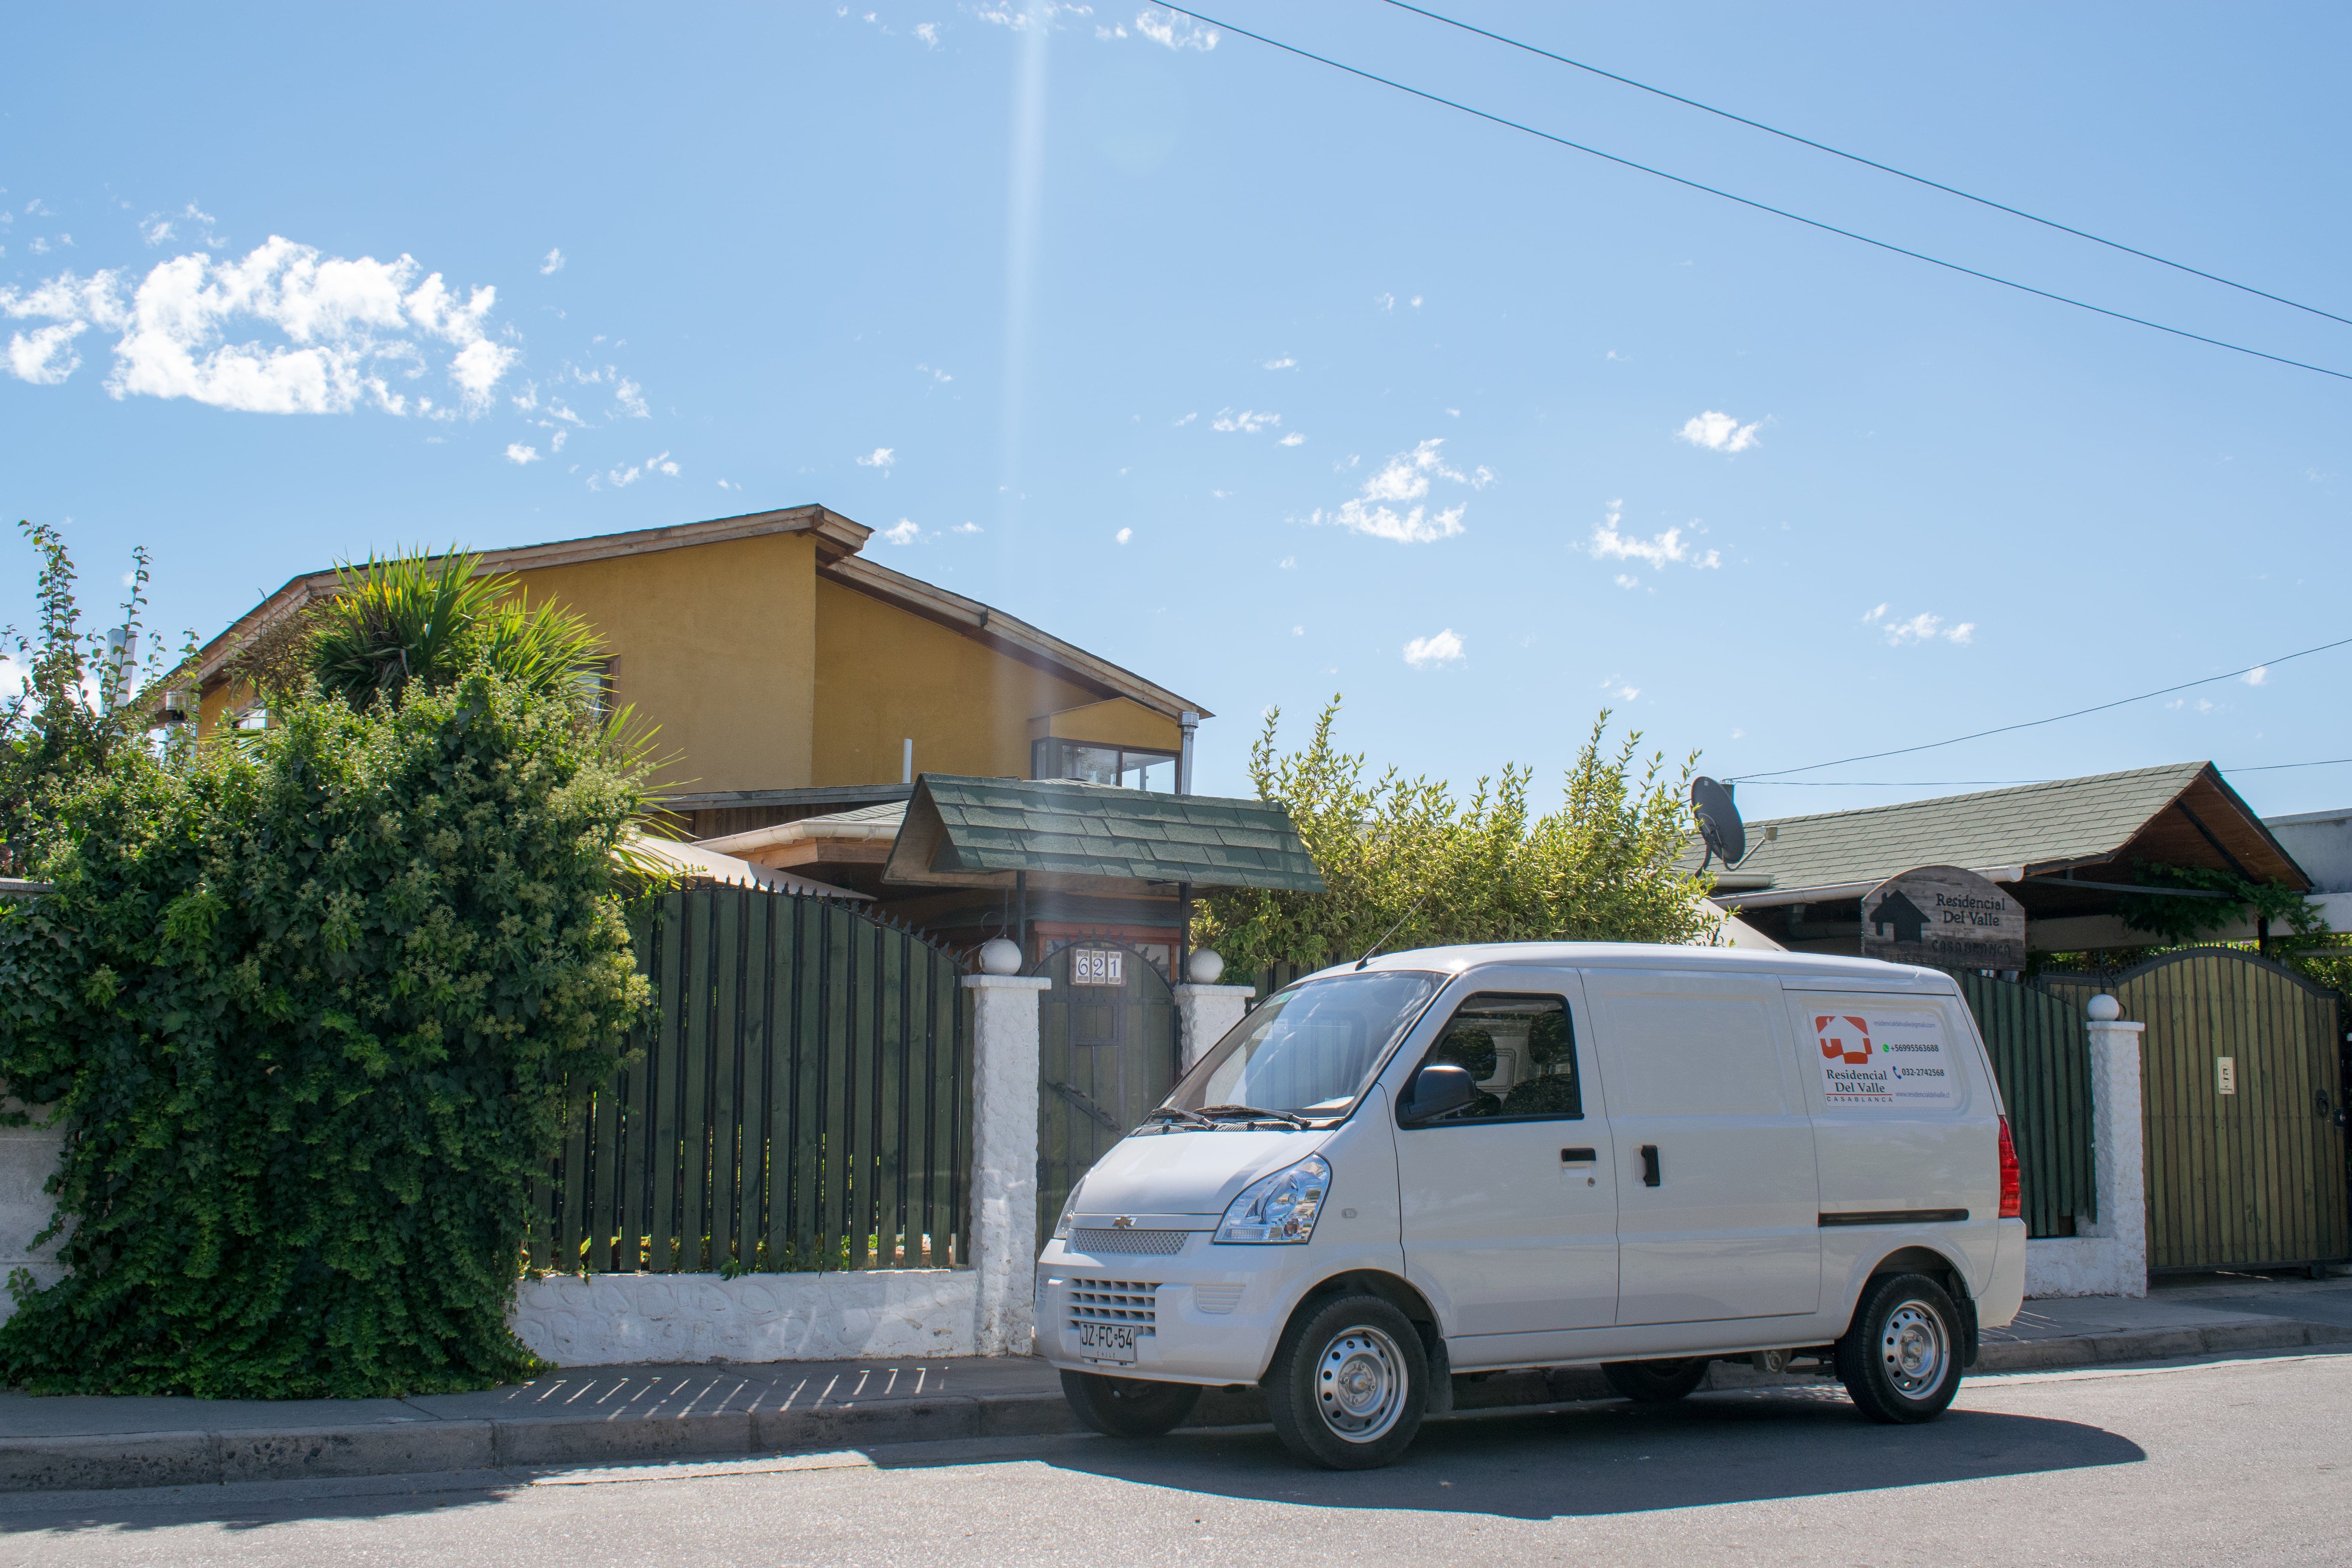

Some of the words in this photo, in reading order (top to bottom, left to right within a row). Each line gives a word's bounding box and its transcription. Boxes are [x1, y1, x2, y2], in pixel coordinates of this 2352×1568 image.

[1936, 893, 2005, 910] Residencial
[1943, 910, 1965, 924] Del
[1969, 911, 1999, 926] Valle
[1078, 957, 1116, 976] 621
[1826, 1069, 1887, 1080] Residencial
[1902, 1068, 1945, 1076] 032-2742568
[1834, 1082, 1855, 1092] Del
[1857, 1082, 1885, 1093] Valle
